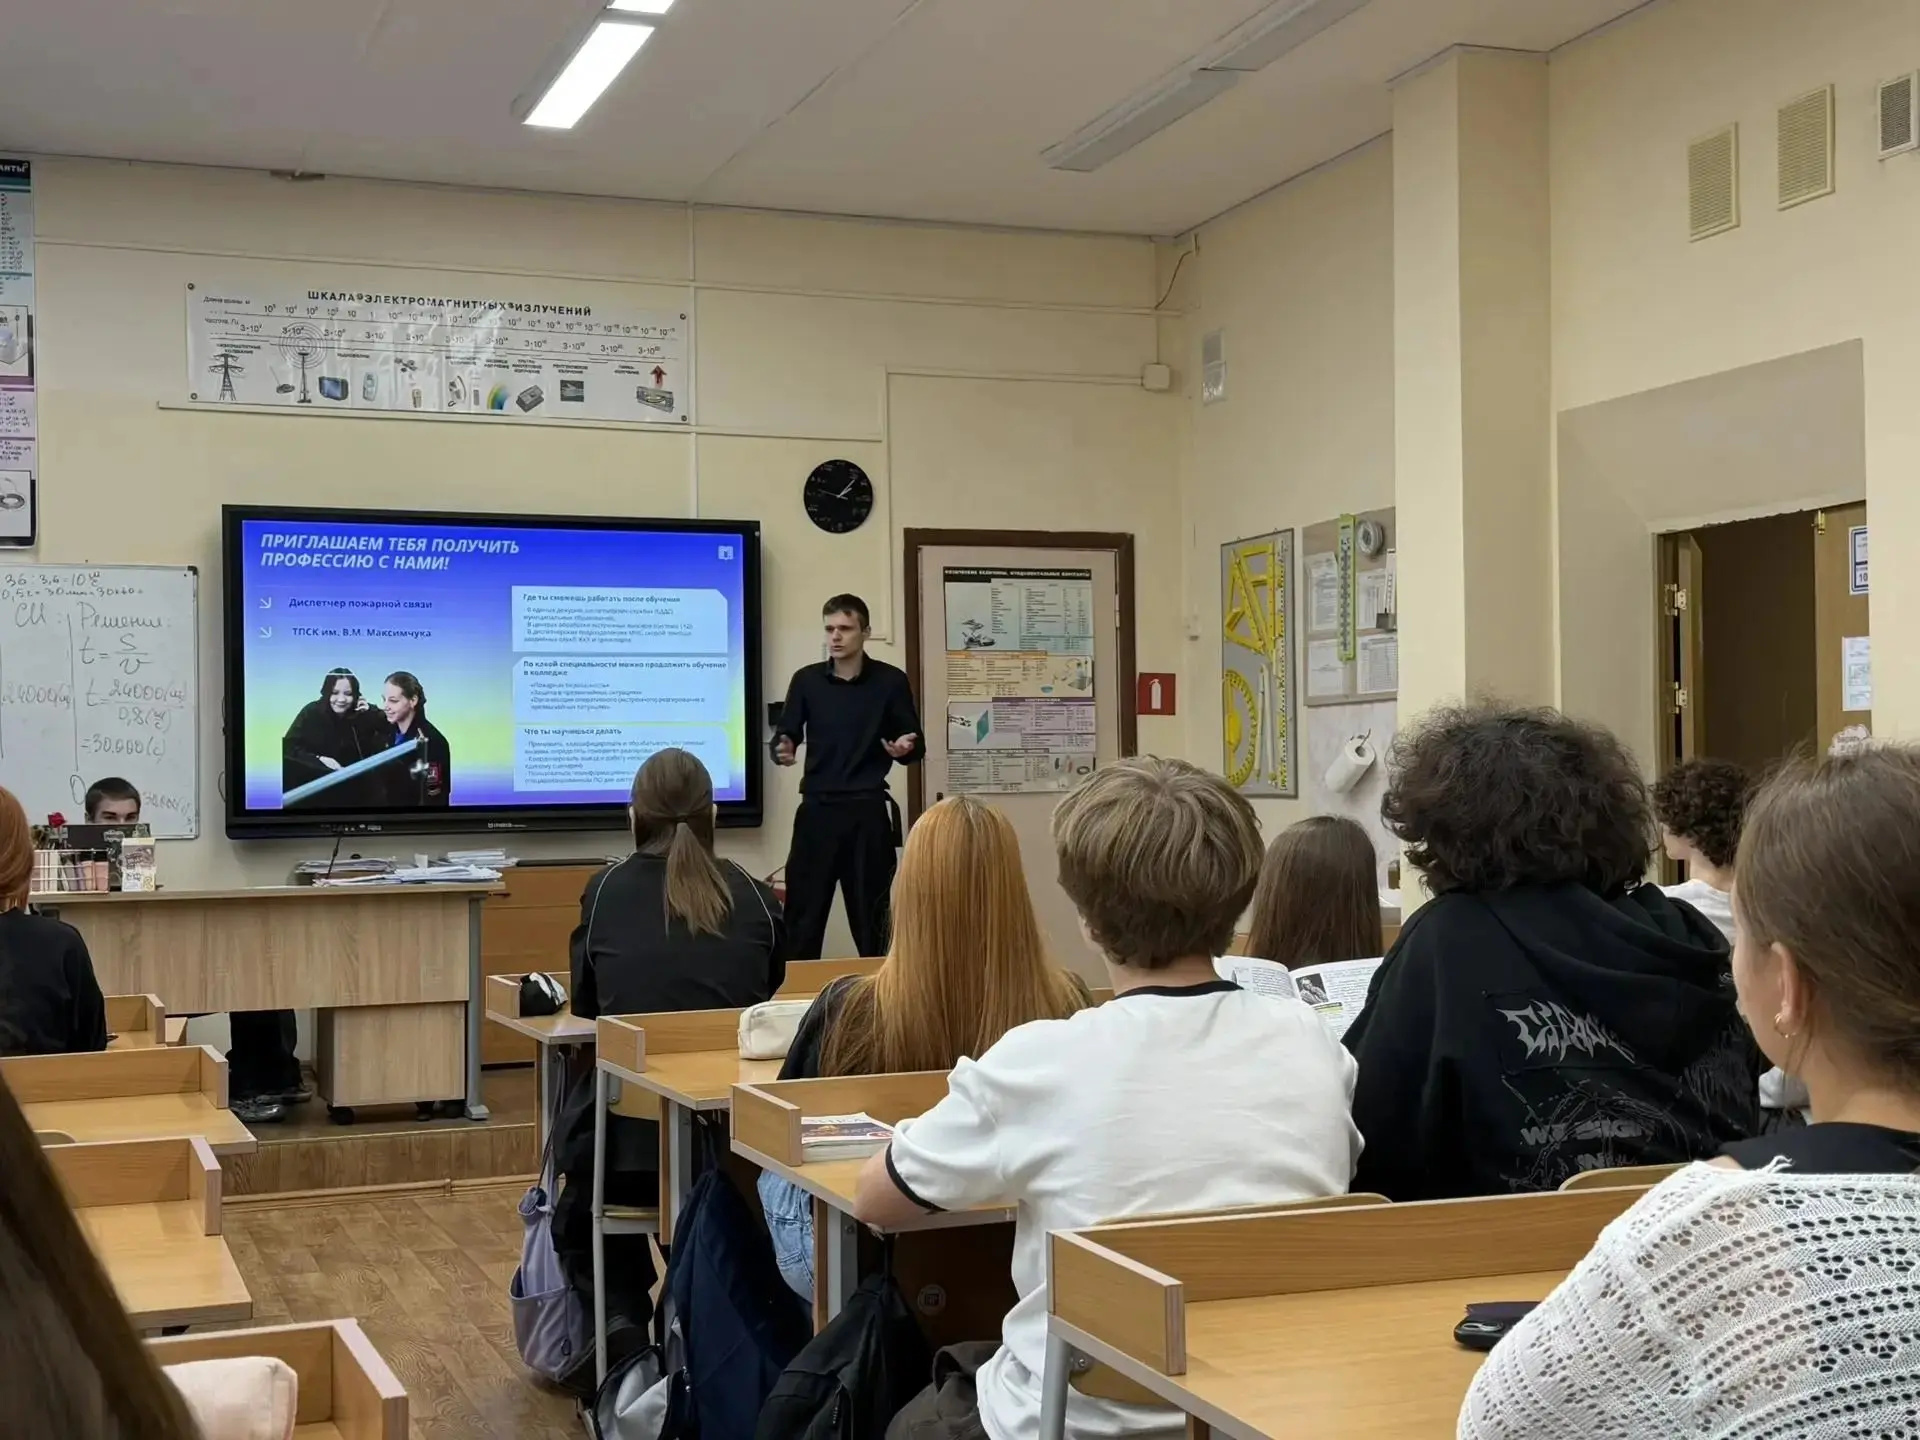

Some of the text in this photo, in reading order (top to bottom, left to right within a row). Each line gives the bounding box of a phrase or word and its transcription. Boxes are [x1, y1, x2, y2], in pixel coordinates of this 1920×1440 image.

[308, 290, 591, 316] ШКАЛА ЭЛЕКТРОМАГНИТНЫХ ИЗЛУЧЕНИЙ
[261, 534, 520, 554] ПРИГЛАШАЕМ ТЕБЯ ПОЛУЧИТЬ
[261, 552, 450, 570] ПРОФЕССИЮ С НАМИ!
[289, 598, 433, 610] Диспетчер пожарной связи
[523, 593, 537, 602] Где
[587, 595, 621, 603] работать
[292, 627, 318, 637] ТПСК
[321, 629, 341, 637] им.
[366, 628, 432, 639] Максимчука
[523, 660, 534, 668] По
[535, 660, 558, 668] какой
[559, 661, 618, 669] специальности
[647, 662, 691, 670] продолжить
[692, 661, 727, 670] обучение
[552, 729, 595, 737] научишься
[595, 728, 622, 736] делать
